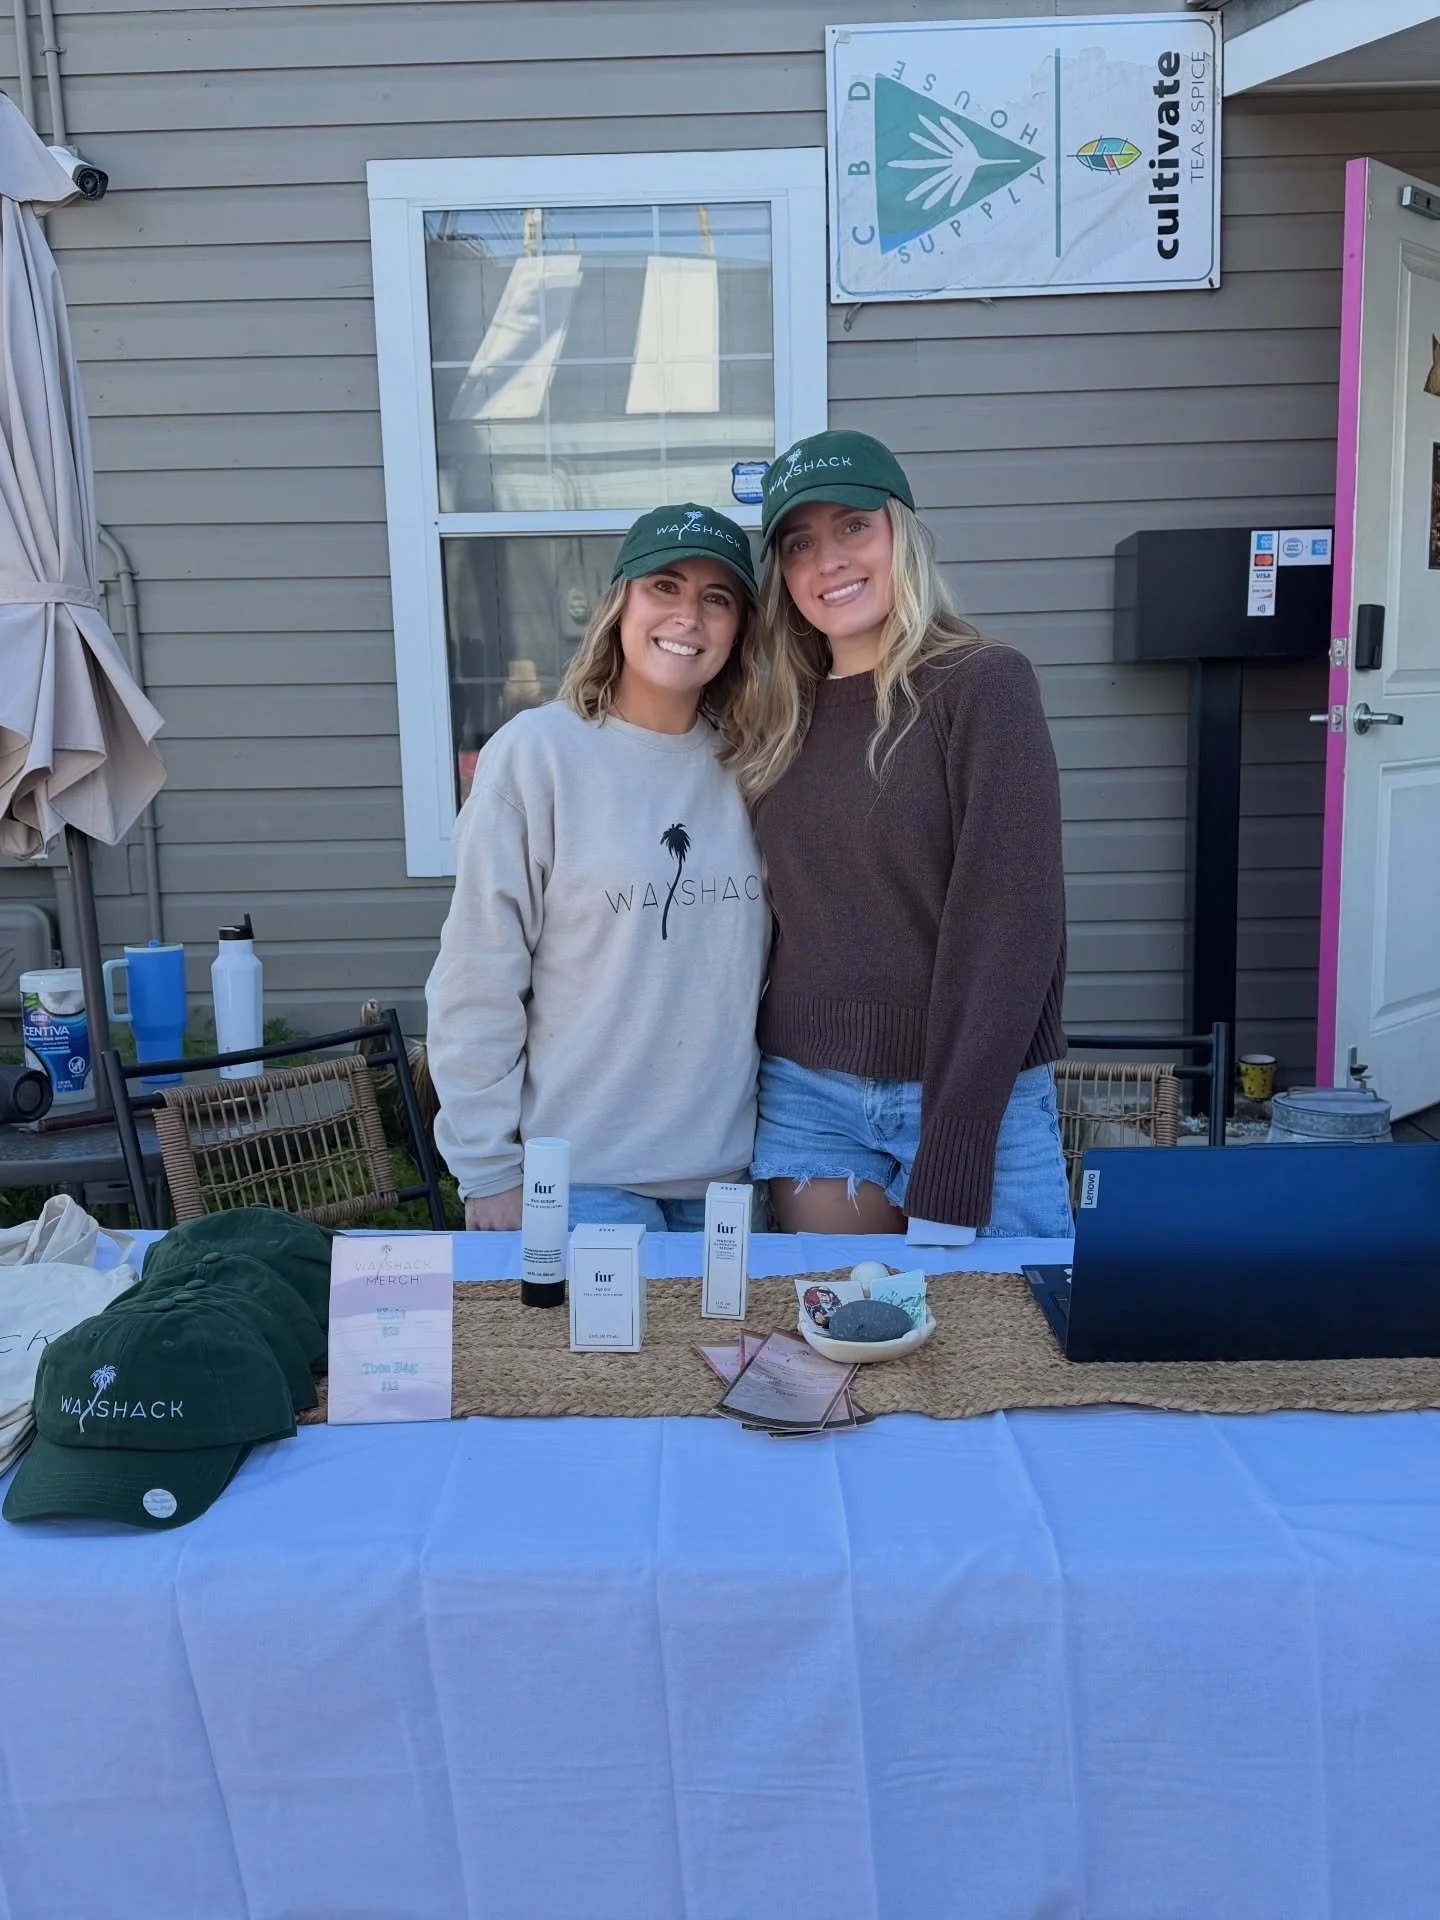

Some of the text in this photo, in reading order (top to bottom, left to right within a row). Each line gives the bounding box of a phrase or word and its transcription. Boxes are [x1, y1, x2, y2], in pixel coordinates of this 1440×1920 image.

[892, 60, 1038, 144] HOUSE
[1190, 51, 1206, 184] TEA & SPICE
[1148, 50, 1180, 260] cultivate
[897, 165, 1046, 264] SUPPLY
[768, 455, 853, 496] WAXSHACK
[656, 521, 743, 551] WAXSHACK
[534, 1181, 556, 1194] fur
[1084, 1173, 1096, 1205] Lenovo
[717, 1221, 737, 1234] fur
[366, 1274, 419, 1286] MERCH
[595, 1270, 615, 1282] fur
